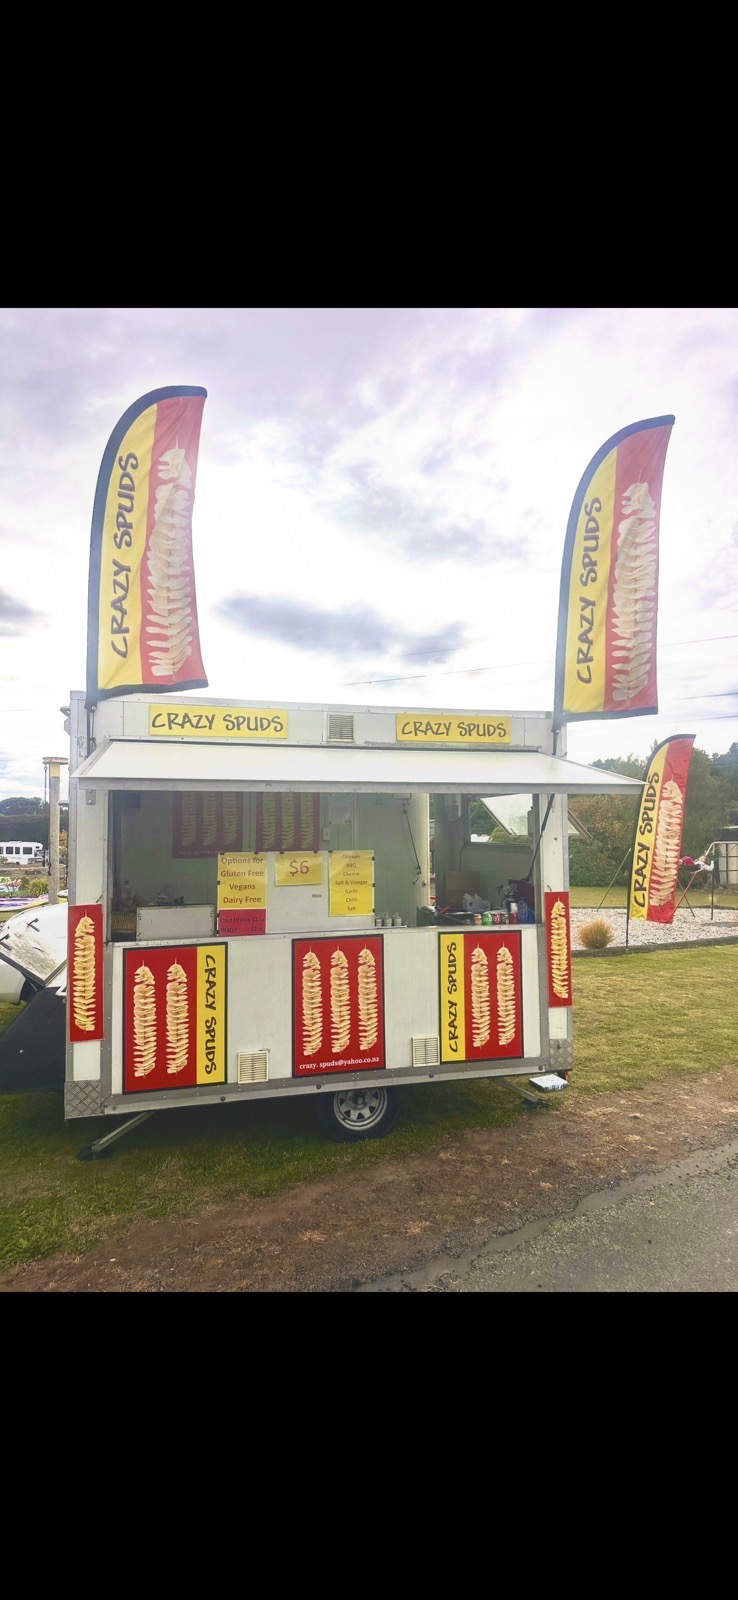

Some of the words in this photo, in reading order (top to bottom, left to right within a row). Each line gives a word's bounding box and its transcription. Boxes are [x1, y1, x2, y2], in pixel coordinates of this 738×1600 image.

[113, 451, 139, 551] SPUDS
[579, 496, 602, 590] SPUDS
[111, 558, 132, 659] CRAZY
[576, 595, 597, 685] CRAZY
[151, 712, 216, 730] CRAZY
[222, 713, 284, 733] SPUDS
[401, 721, 452, 737] CRAZY
[457, 721, 507, 738] SPUDS
[638, 771, 660, 837] SPUDS
[220, 870, 246, 878] Gluten
[248, 869, 265, 877] Free
[221, 856, 251, 865] Options
[252, 856, 264, 864] for
[229, 883, 256, 891] Vegans
[289, 858, 309, 877] $6
[633, 841, 651, 908] CRAZY
[223, 896, 244, 904] Dairy
[204, 954, 217, 1011] CRAZY
[446, 941, 458, 995] SPUDS
[204, 1016, 217, 1075] SPUDS
[447, 1000, 459, 1053] CRAZY
[319, 1056, 380, 1069] spuds@yahoo.co.nz
